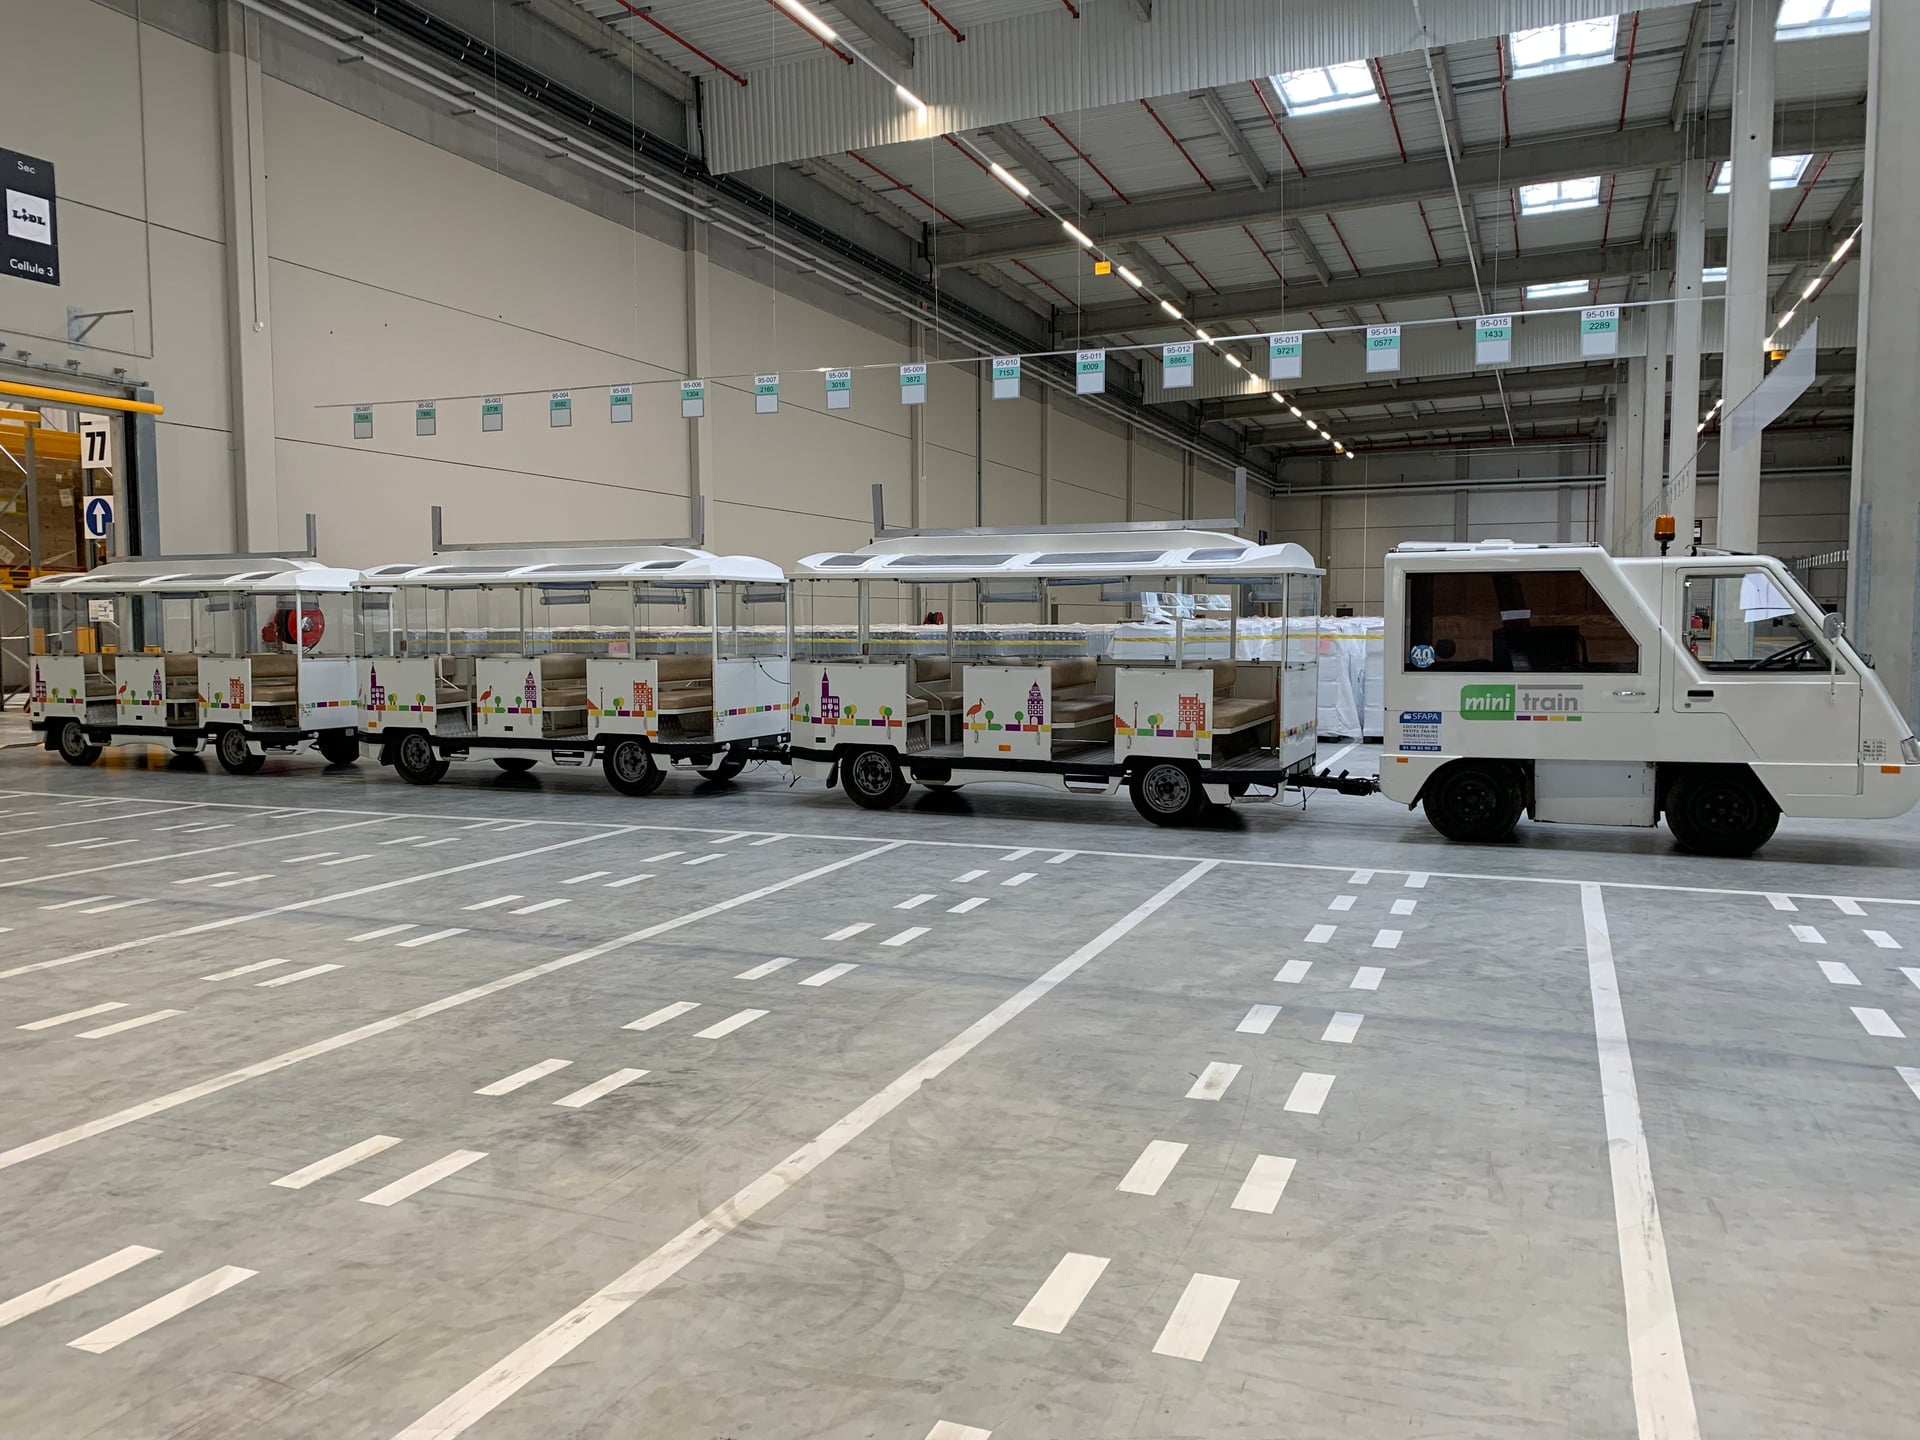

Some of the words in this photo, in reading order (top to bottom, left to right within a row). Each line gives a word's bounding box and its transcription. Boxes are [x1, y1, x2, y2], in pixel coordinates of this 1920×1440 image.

[17, 160, 36, 174] Sec
[9, 258, 45, 275] Cellule
[46, 267, 54, 277] 3
[1586, 310, 1615, 318] 95-016
[1480, 318, 1508, 327] 95-015
[1589, 321, 1610, 330] 2289
[1371, 328, 1397, 336] 95-014
[1484, 330, 1503, 338] 1433
[1274, 336, 1299, 344] 95-013
[1374, 339, 1393, 347] 0577
[1166, 346, 1190, 354] 95-012
[1276, 347, 1294, 355] 9721
[1080, 352, 1102, 360] 95-011
[85, 431, 106, 461] 77
[1465, 693, 1511, 711] mini
[1522, 693, 1578, 711] train
[1412, 712, 1438, 720] SFAPA
